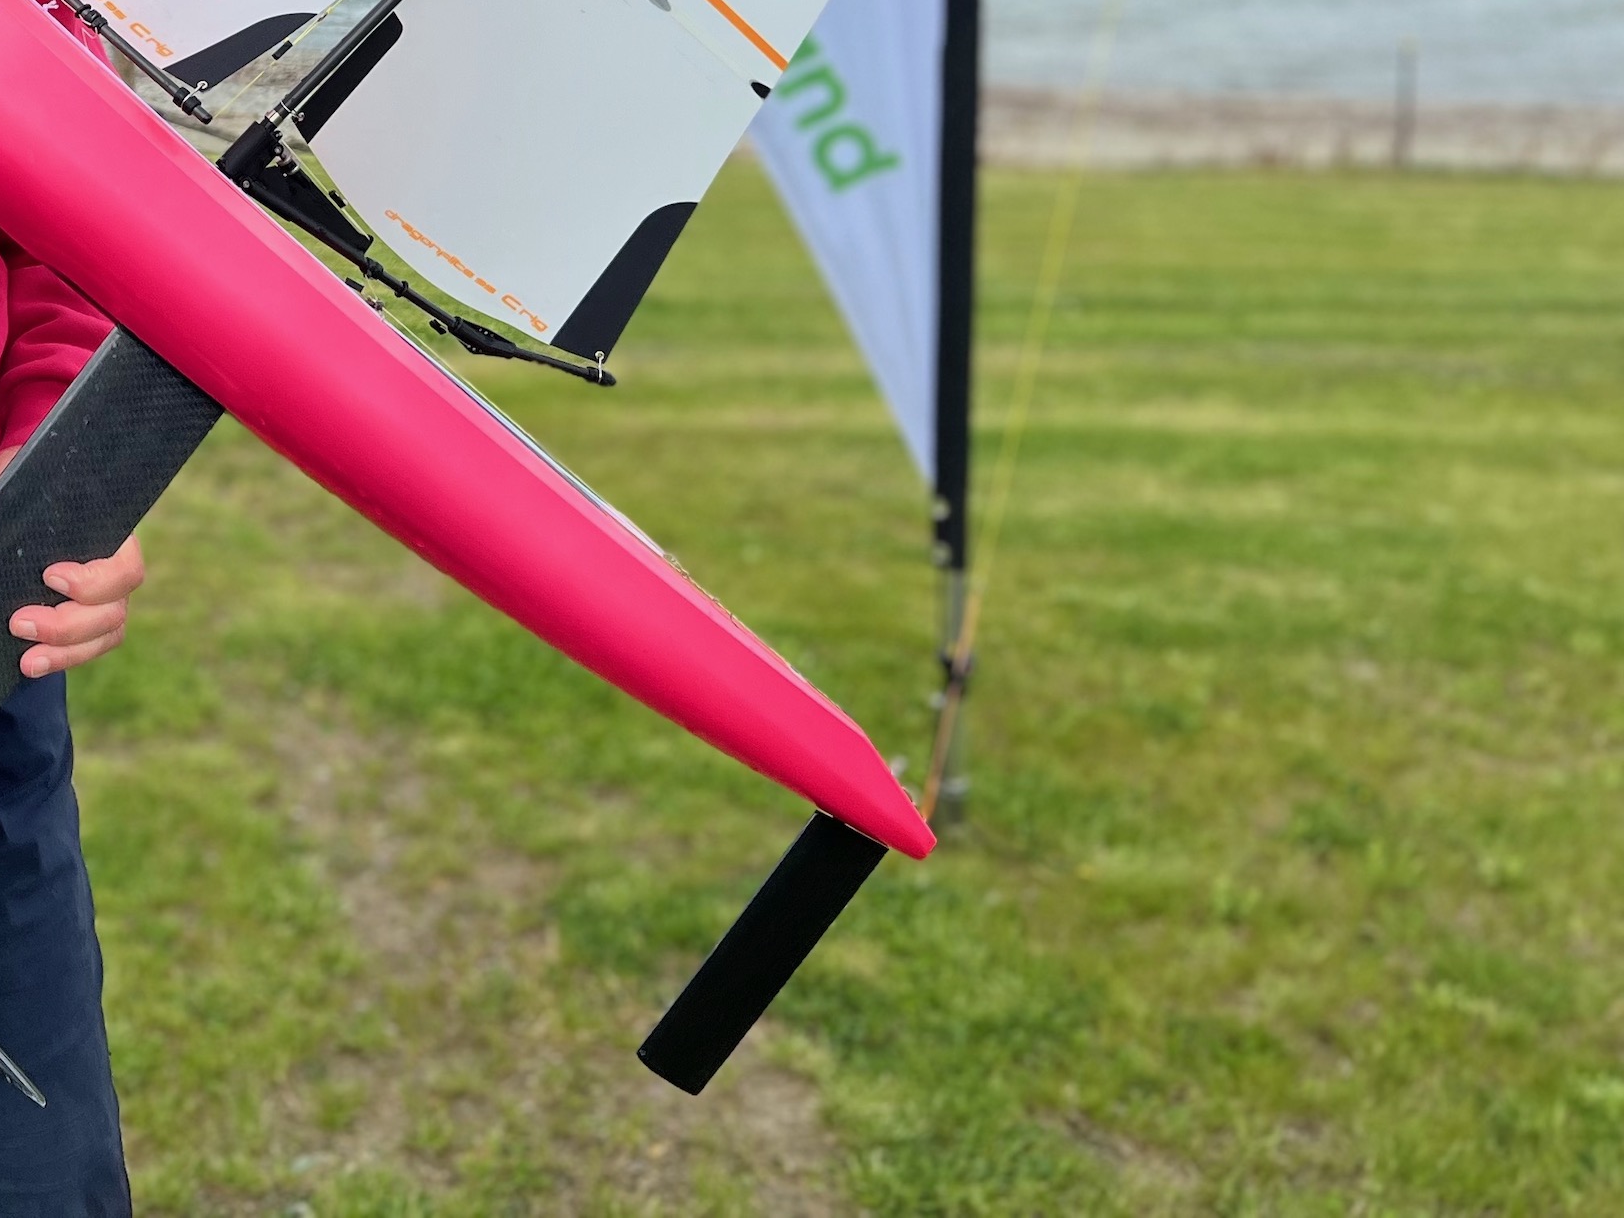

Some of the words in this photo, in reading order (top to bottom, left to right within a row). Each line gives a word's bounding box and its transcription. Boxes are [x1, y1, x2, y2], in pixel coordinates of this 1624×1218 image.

[129, 22, 152, 39] C
[146, 37, 174, 58] rig
[778, 30, 902, 197] nd
[501, 294, 523, 312] C
[519, 308, 548, 333] rig
